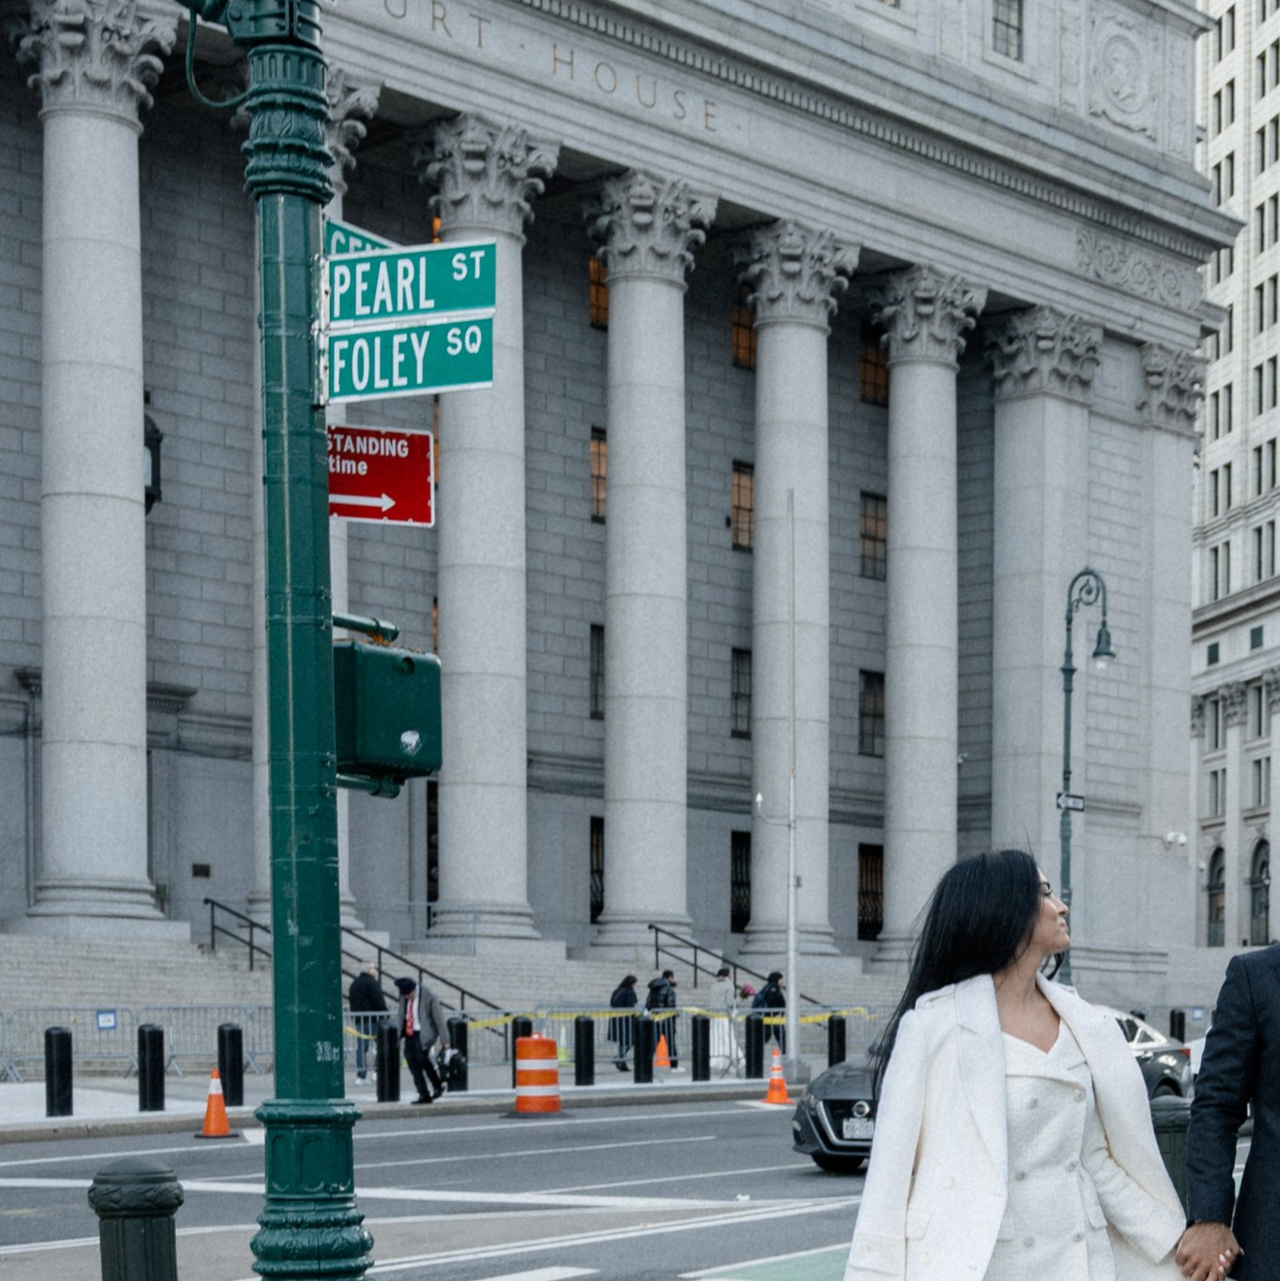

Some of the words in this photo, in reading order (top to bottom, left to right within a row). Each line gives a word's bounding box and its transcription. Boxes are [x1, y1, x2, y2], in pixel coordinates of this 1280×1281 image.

[551, 43, 718, 133] HOUSE
[333, 256, 435, 318] PEARL
[452, 250, 485, 281] ST
[333, 330, 431, 393] FOLEY
[446, 325, 482, 355] SQ
[328, 454, 368, 476] time
